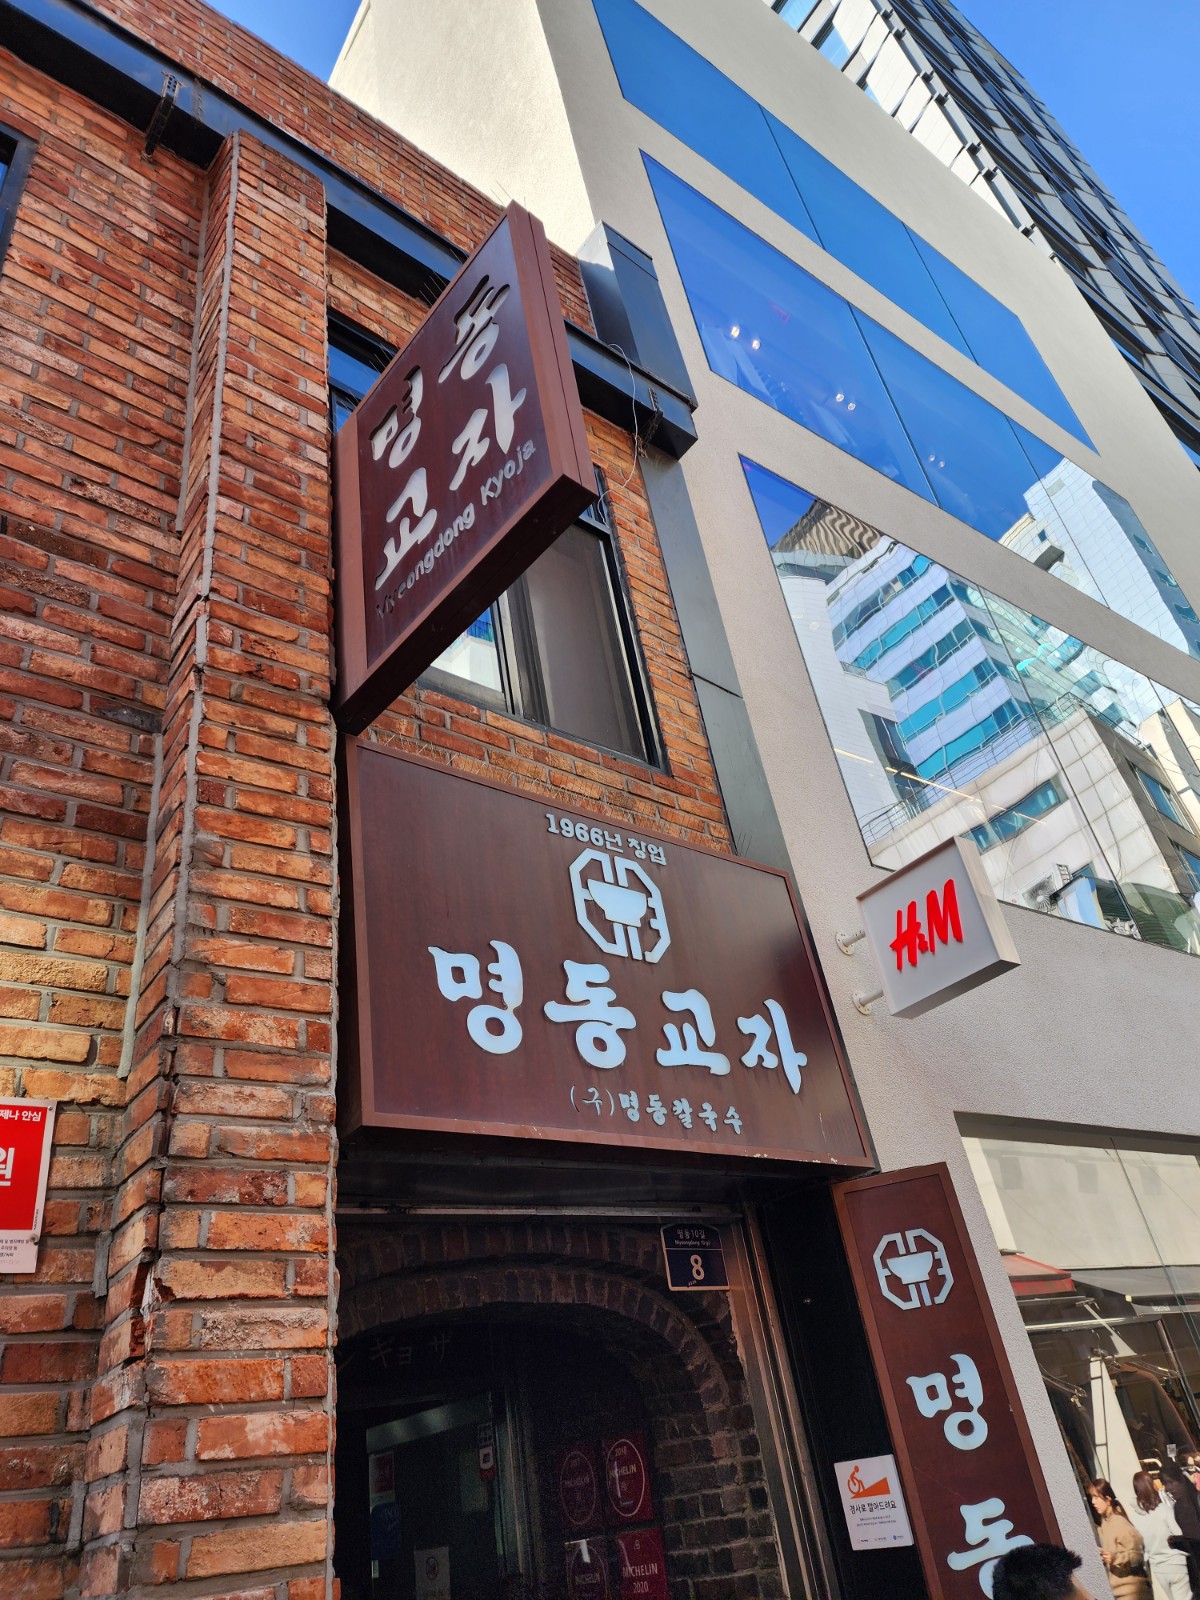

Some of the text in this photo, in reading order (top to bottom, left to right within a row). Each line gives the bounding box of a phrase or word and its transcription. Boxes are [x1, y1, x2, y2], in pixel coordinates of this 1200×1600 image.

[368, 274, 511, 469] 명동
[375, 363, 527, 591] 교자
[376, 439, 536, 619] Myeongdong Kyoja
[545, 813, 667, 866] 1966년 창업
[889, 878, 963, 971] H&M
[428, 940, 808, 1094] 명동교자
[22, 1110, 42, 1122] 안심
[690, 1254, 705, 1280] 8
[622, 1563, 658, 1578] MICHELIN
[633, 1581, 649, 1593] 2020
